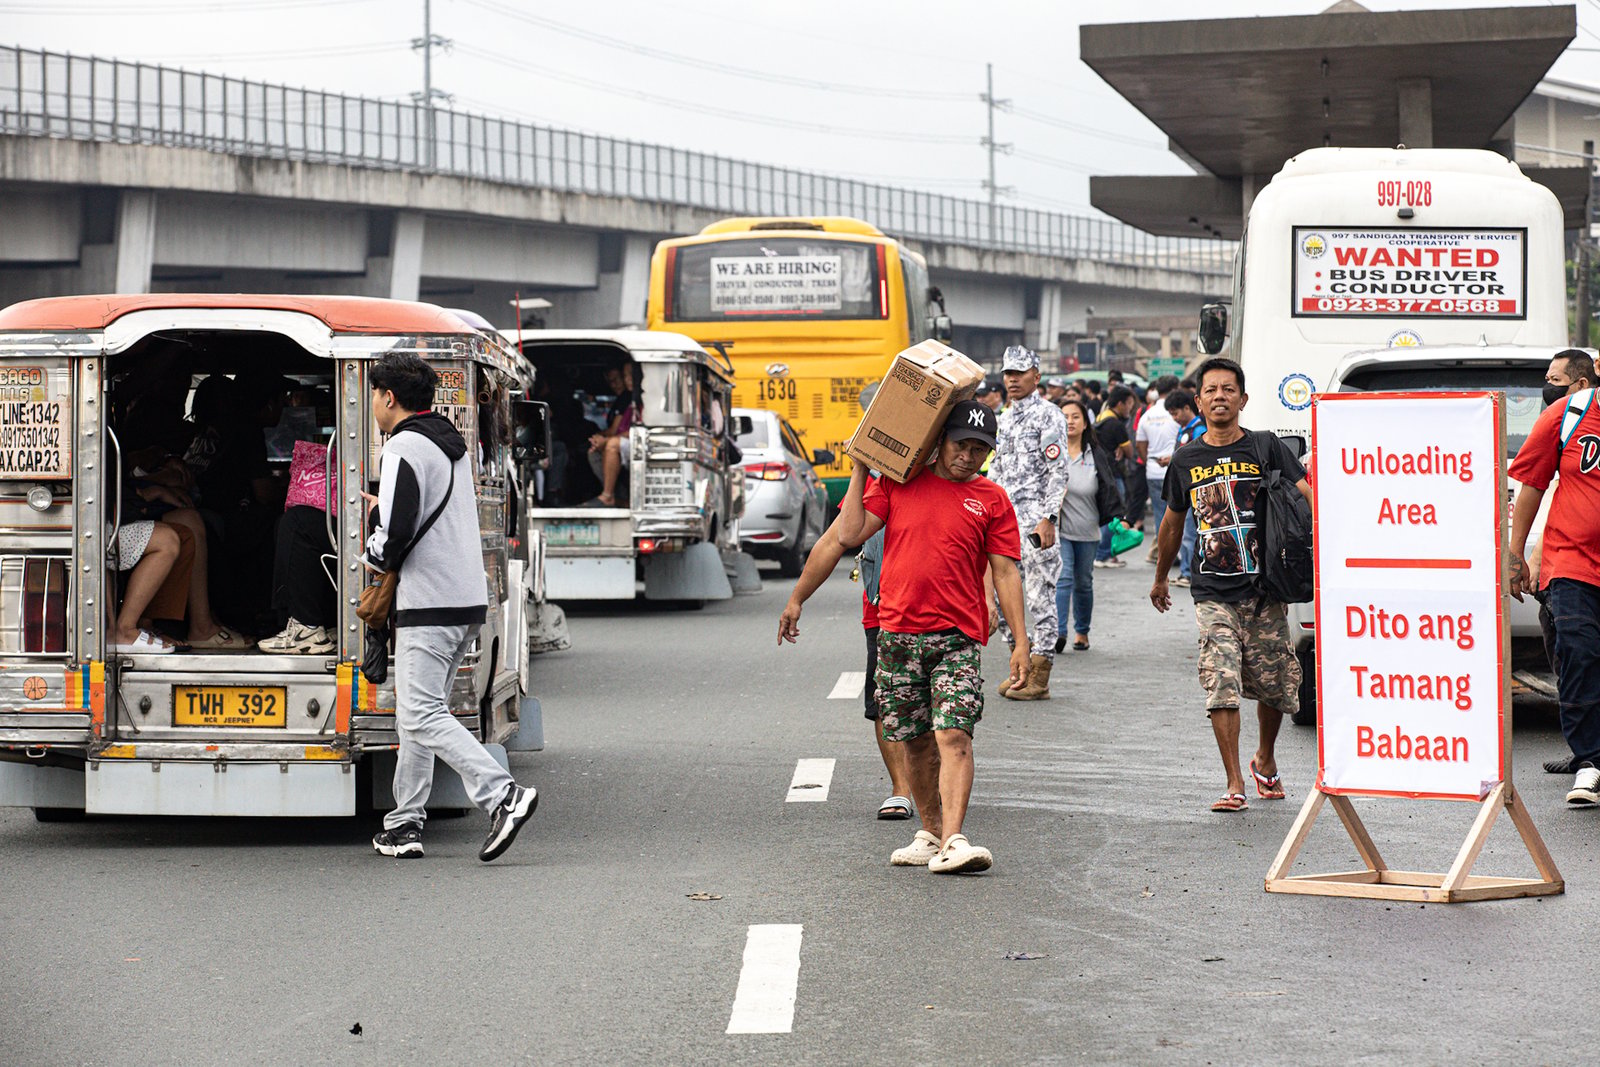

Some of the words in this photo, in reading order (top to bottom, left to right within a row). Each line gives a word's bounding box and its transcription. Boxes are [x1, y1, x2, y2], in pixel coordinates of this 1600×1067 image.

[1378, 181, 1432, 207] 997-028
[717, 263, 739, 275] WE
[743, 263, 774, 275] ARE
[778, 261, 837, 274] HIRING!
[1334, 247, 1500, 268] WANTED
[753, 280, 804, 289] CONDUCTOR
[1330, 270, 1385, 281] BUS
[1395, 270, 1498, 282] DRIVER
[1330, 283, 1505, 295] CONDUCTOR
[1317, 299, 1500, 312] 0923-377-0568
[0, 388, 29, 402] LLS
[1341, 445, 1474, 482] Unloading
[1577, 434, 1600, 474] D
[1190, 462, 1260, 484] BEATLES
[1377, 497, 1438, 525] Area
[1345, 604, 1409, 639] Dito
[1418, 612, 1475, 650] ang
[1349, 665, 1473, 711] Tamang
[186, 693, 224, 715] TWH
[238, 694, 277, 717] 392
[1357, 725, 1470, 763] Babaan
